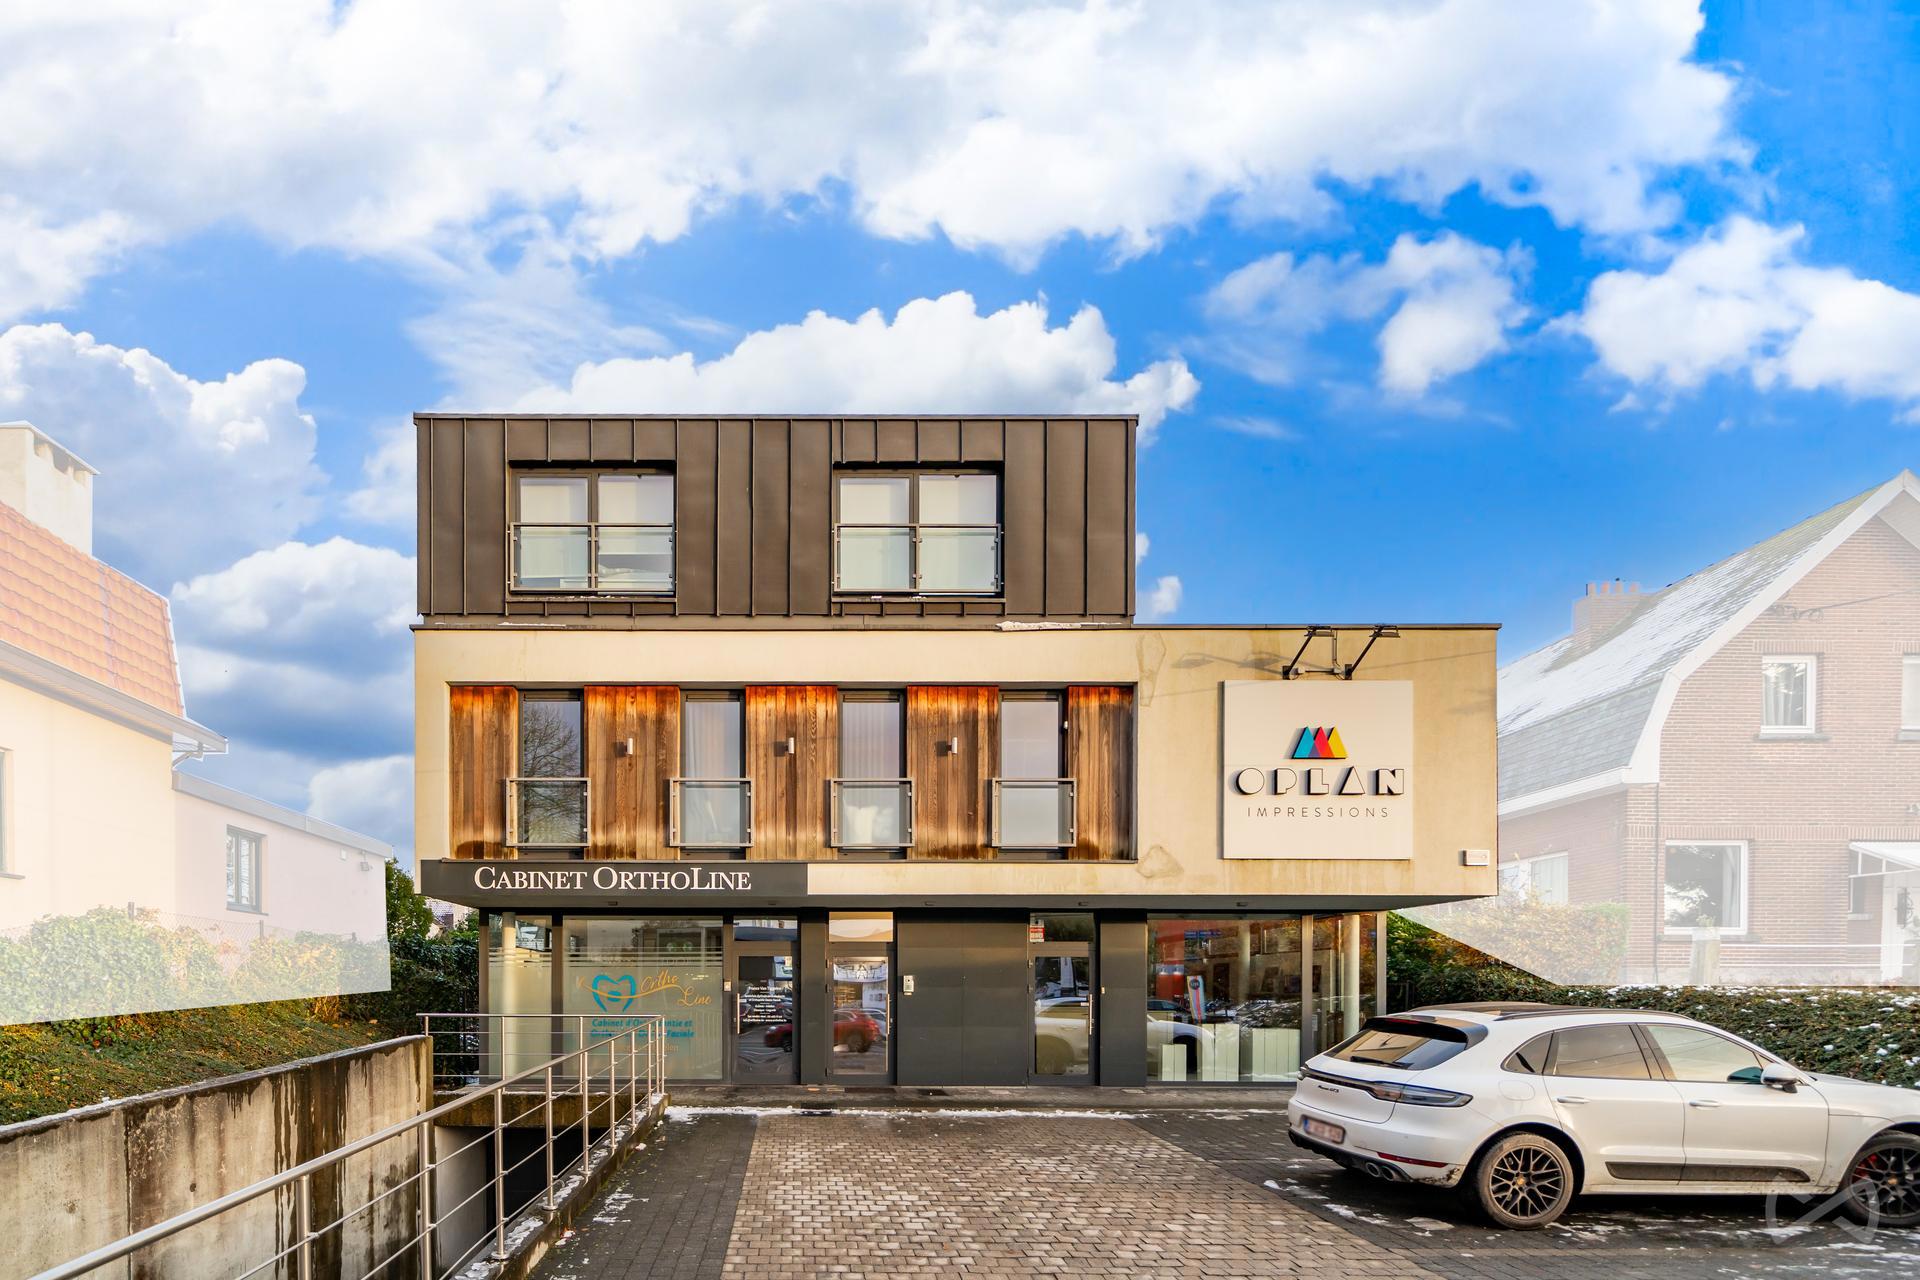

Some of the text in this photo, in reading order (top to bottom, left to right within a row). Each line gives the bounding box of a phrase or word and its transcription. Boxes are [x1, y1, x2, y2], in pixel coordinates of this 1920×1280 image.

[1235, 766, 1405, 796] OPLAN
[1247, 807, 1389, 818] IMPRESSIONS
[474, 866, 588, 890] CABINET
[640, 969, 679, 993] Ortho
[678, 985, 712, 1007] Line
[591, 1018, 623, 1028] Cabinet
